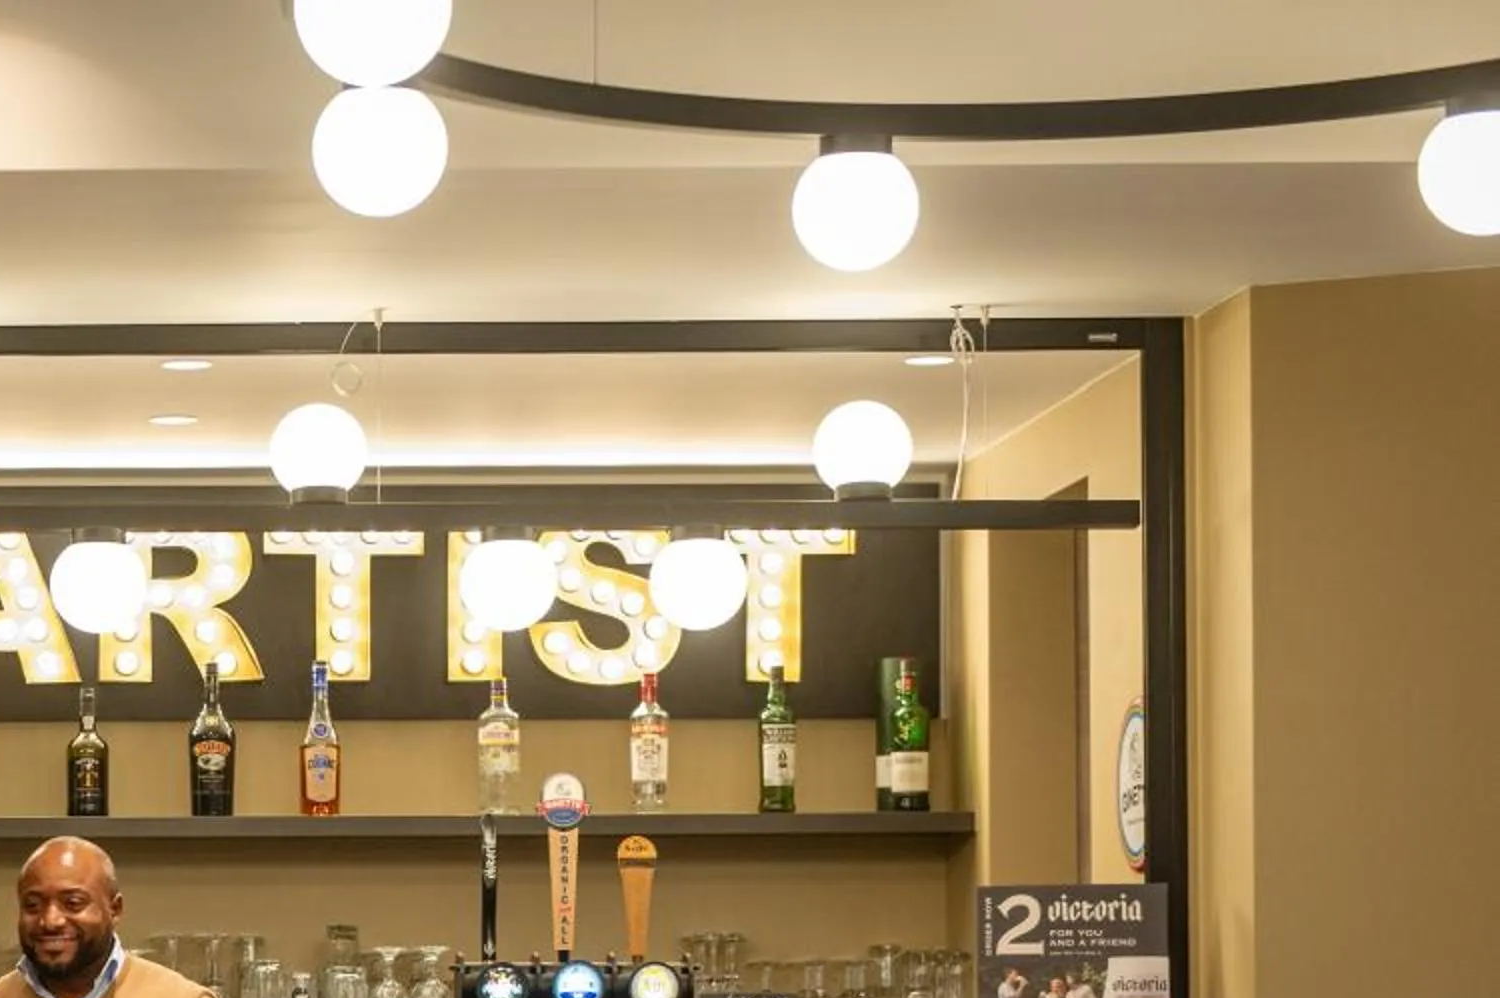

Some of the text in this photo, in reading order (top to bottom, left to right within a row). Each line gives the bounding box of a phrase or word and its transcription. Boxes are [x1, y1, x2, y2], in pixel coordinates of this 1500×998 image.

[996, 894, 1142, 955] 2 victoria
[1077, 929, 1104, 937] YOU
